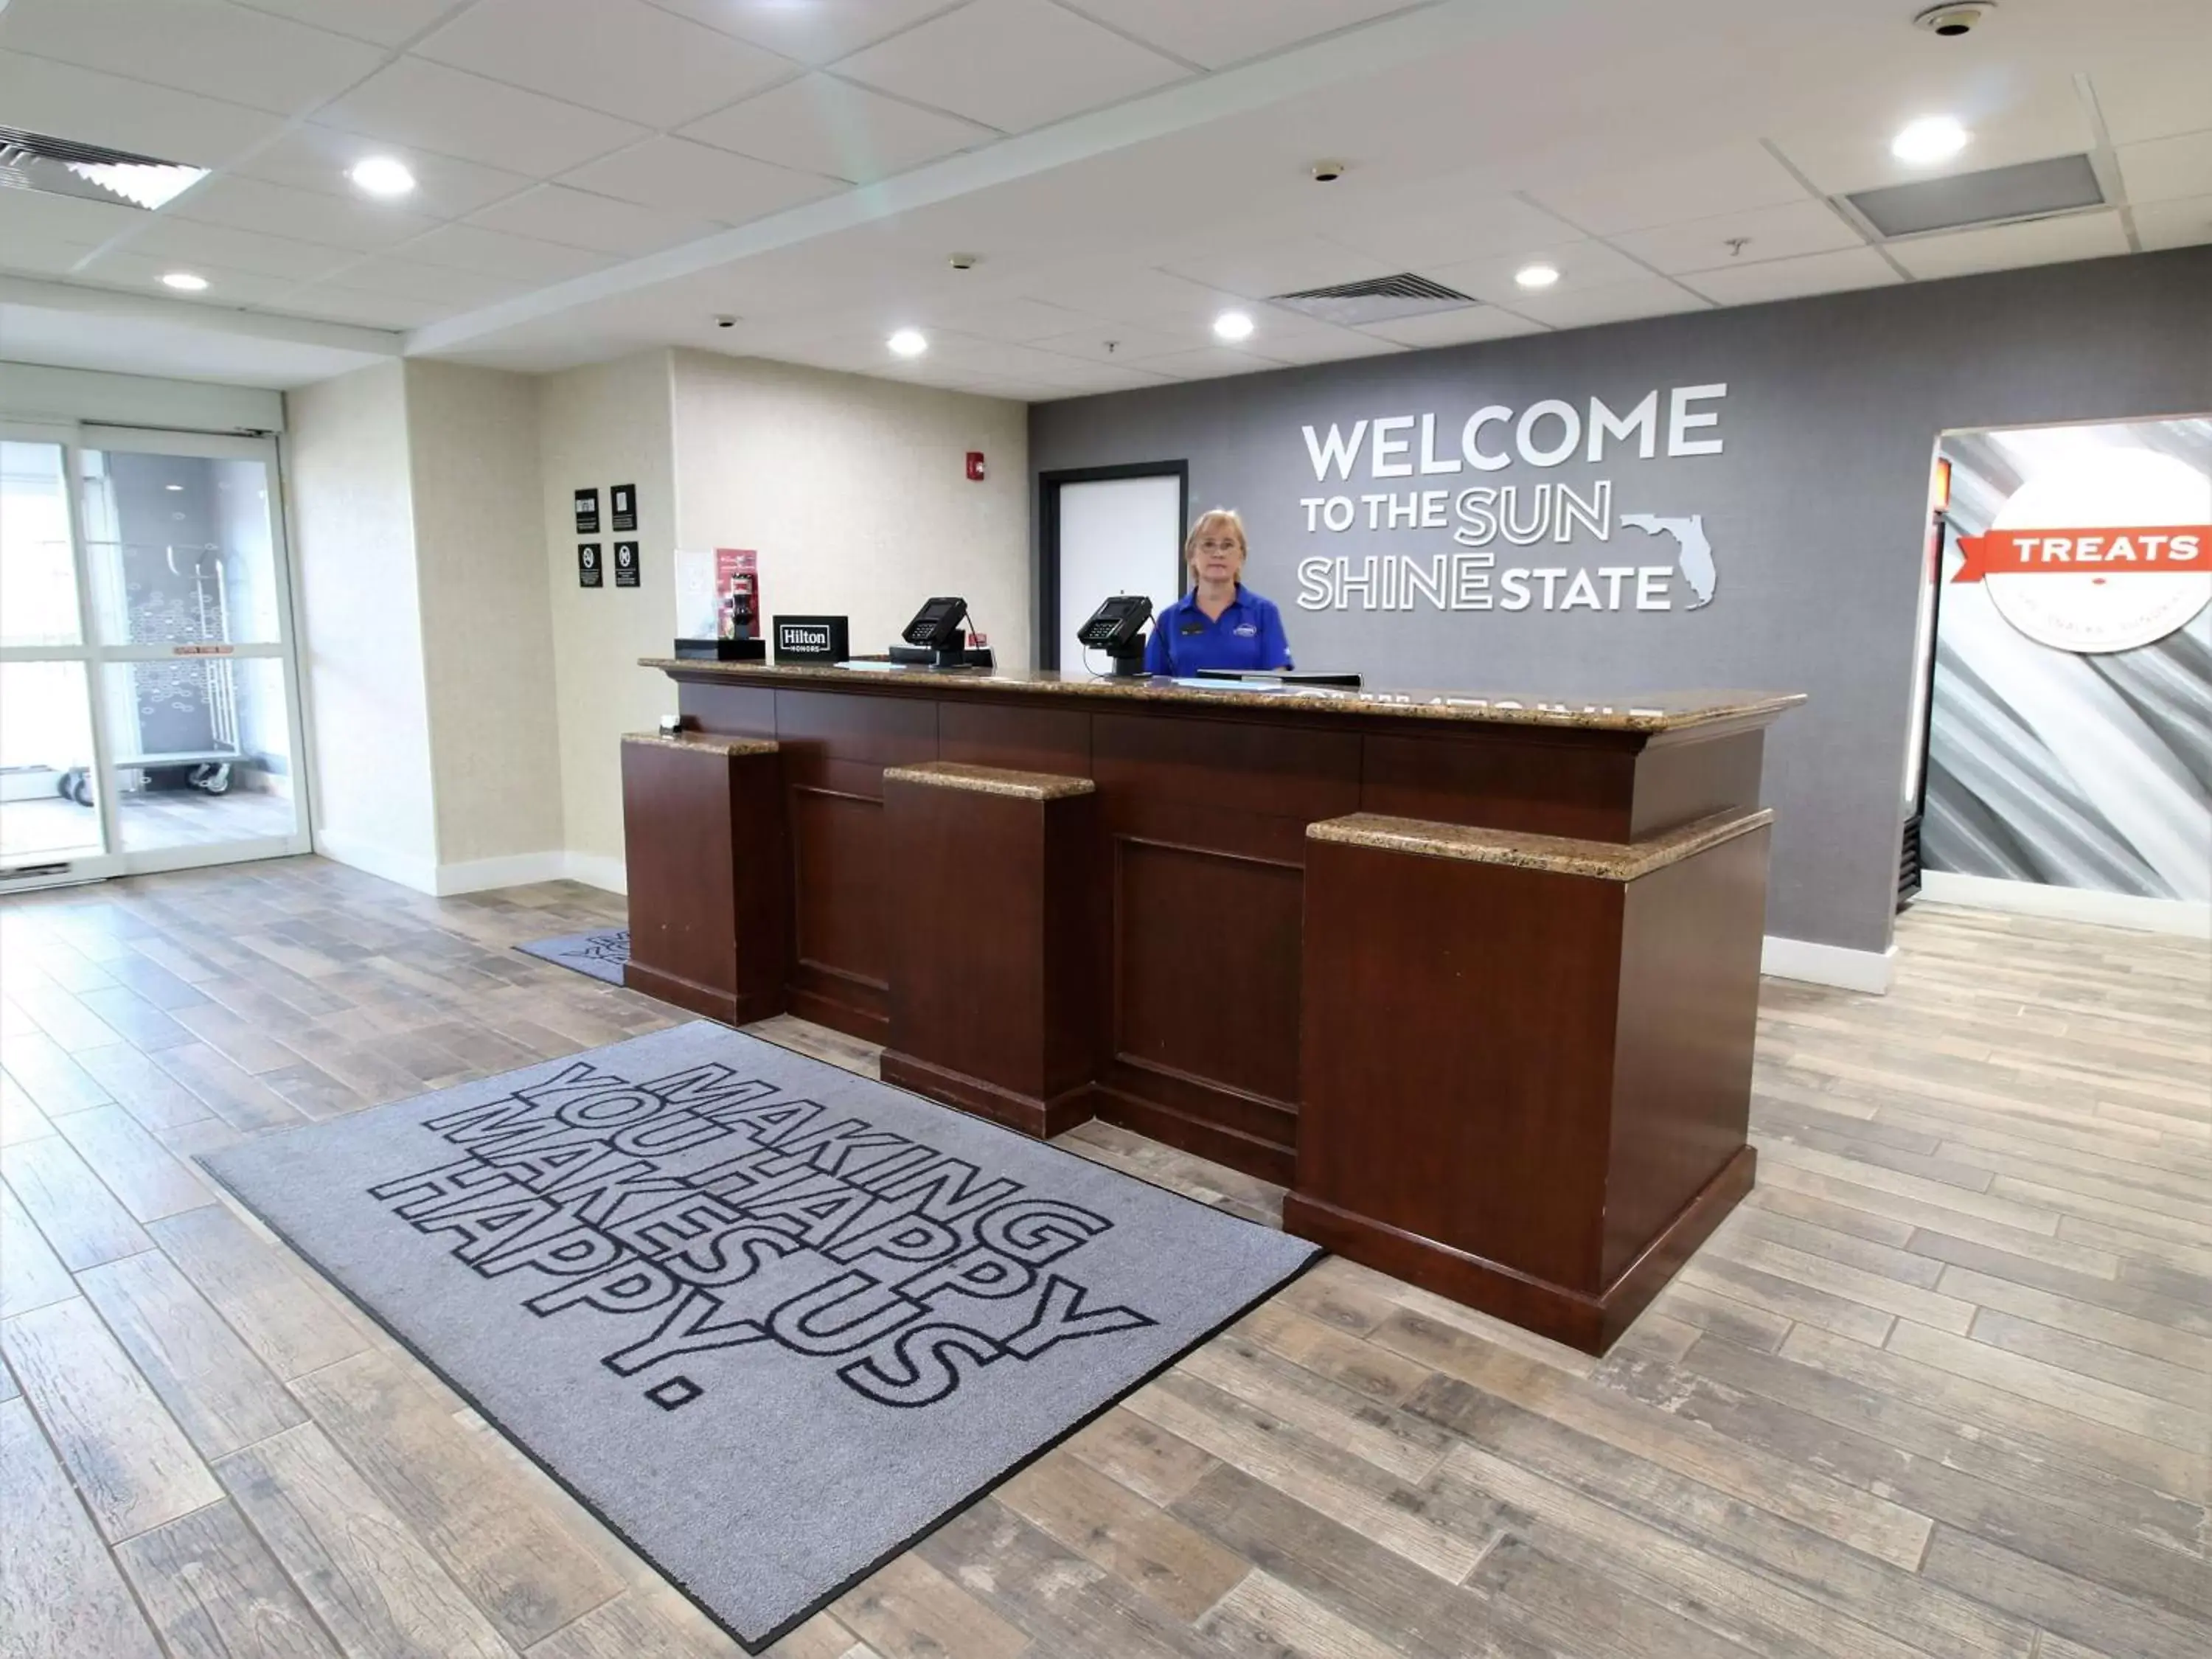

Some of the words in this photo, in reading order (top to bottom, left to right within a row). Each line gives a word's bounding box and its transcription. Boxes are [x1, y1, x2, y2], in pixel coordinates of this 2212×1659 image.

[1301, 383, 1727, 481] WELCOME
[1301, 496, 1354, 532] TO
[1361, 490, 1449, 529] THE
[1453, 480, 1612, 547] SUN
[2012, 535, 2200, 562] TREATS
[1297, 552, 1495, 611] SHINE
[1500, 566, 1674, 611] STATE
[784, 629, 826, 644] Hilton
[510, 1061, 737, 1158] YOU
[674, 1146, 1161, 1362] HAPPY
[634, 1062, 1115, 1268] MAKING
[366, 1157, 776, 1411] HAPPY.
[420, 1096, 807, 1287] MAKES
[764, 1269, 1009, 1408] US
